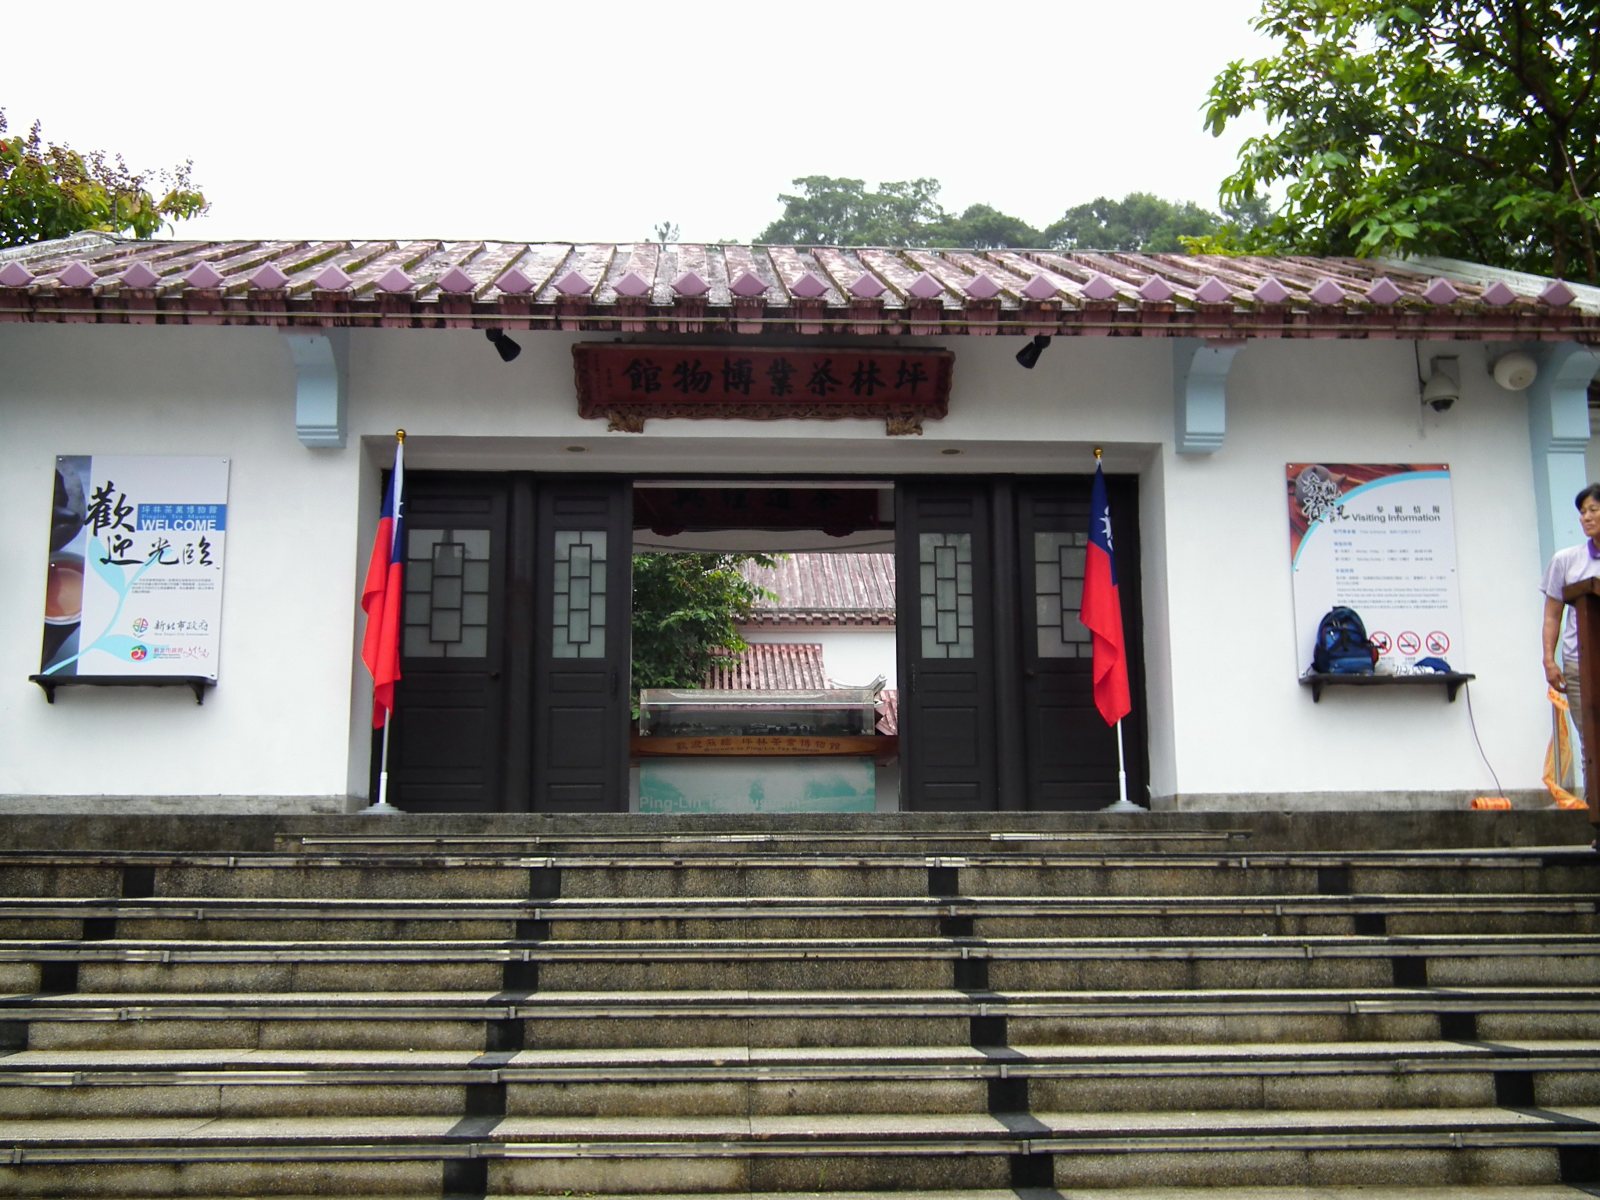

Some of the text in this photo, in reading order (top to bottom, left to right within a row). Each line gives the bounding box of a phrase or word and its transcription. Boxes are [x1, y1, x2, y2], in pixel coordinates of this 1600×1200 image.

[622, 357, 929, 397] 坪林茶業博物館
[83, 480, 135, 536] 歡
[141, 519, 217, 531] WELCOME
[1352, 513, 1441, 523] Visiting Information
[639, 796, 701, 811] Ping-Lin
